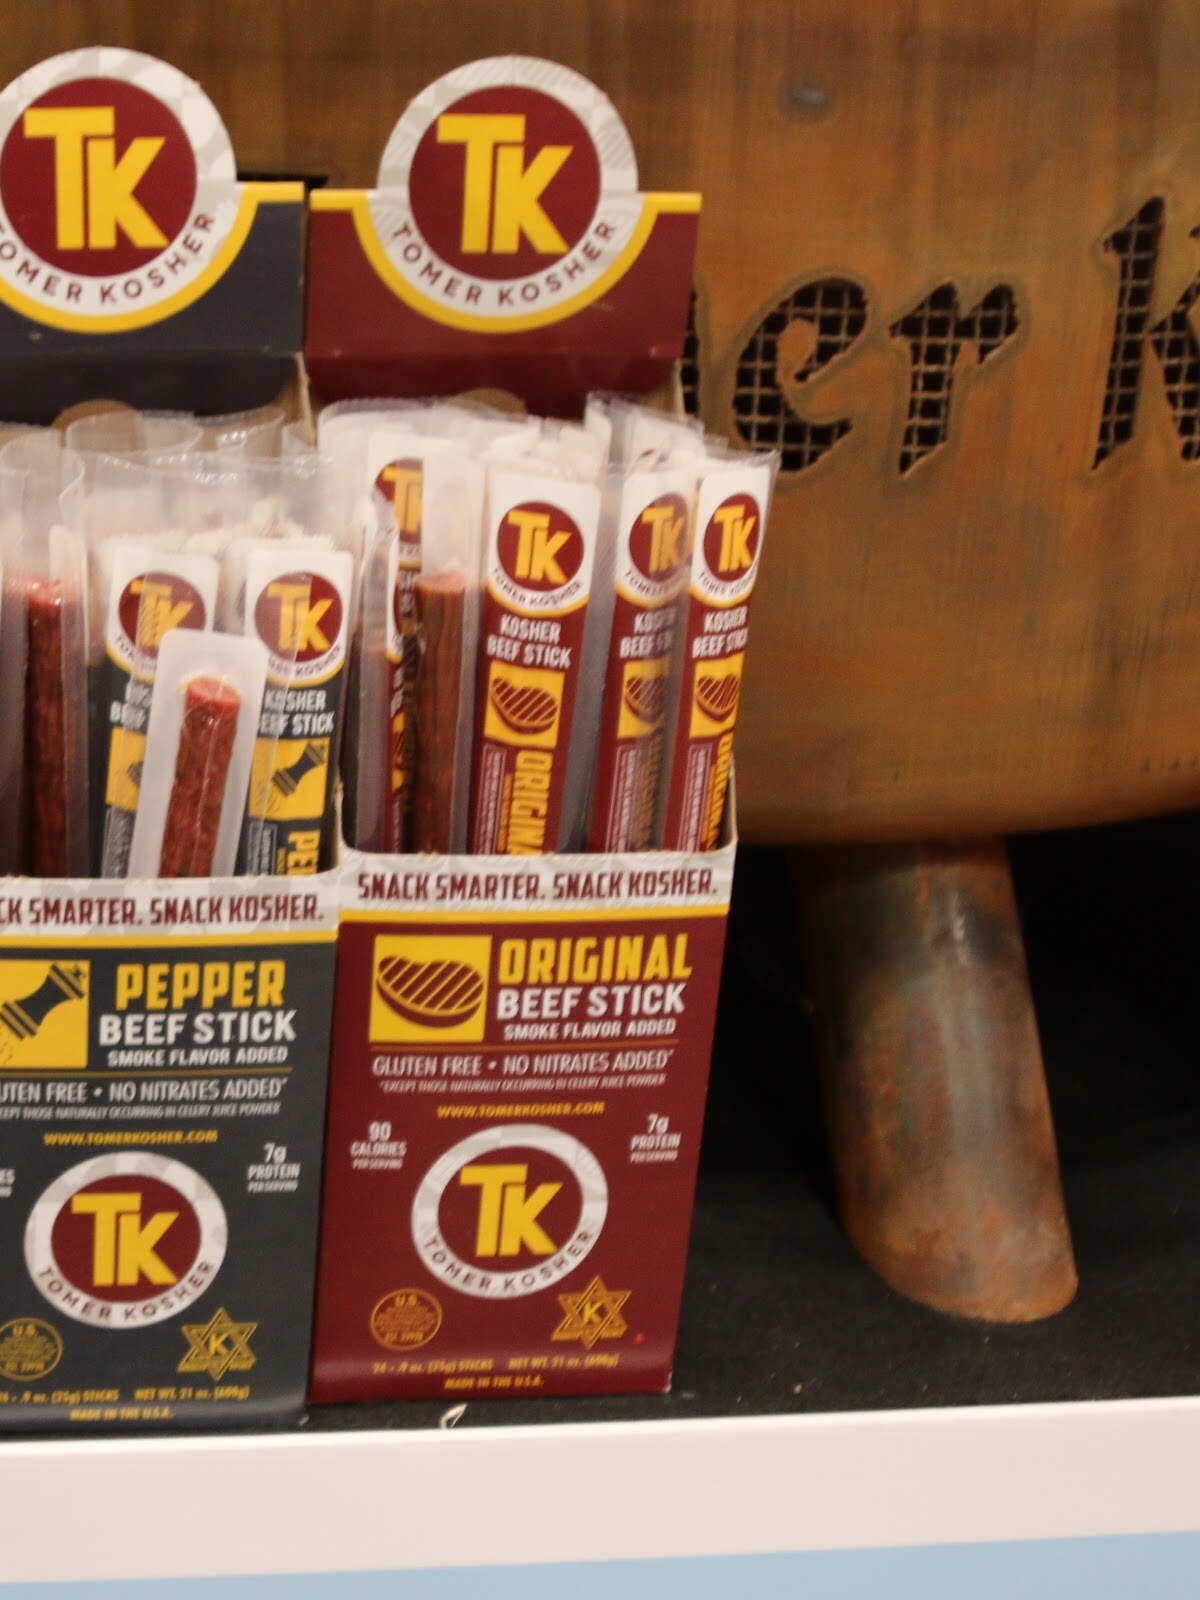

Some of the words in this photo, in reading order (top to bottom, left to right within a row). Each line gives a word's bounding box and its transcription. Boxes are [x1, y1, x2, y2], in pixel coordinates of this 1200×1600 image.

[100, 213, 214, 303] KOSHER
[394, 221, 480, 304] TOMER
[500, 223, 615, 306] KOSHER
[682, 277, 1020, 476] er
[501, 614, 561, 644] KOSHER
[486, 634, 522, 662] BEEF
[523, 643, 572, 669] STICK
[692, 634, 726, 660] BEEF
[265, 689, 327, 712] KOSHER
[291, 711, 335, 736] STICK
[358, 873, 429, 901] SNACK
[436, 873, 545, 900] SMARTER.
[553, 871, 622, 898] SNACK
[629, 868, 717, 897] KOSHER.
[29, 898, 143, 925] SMARTER.
[150, 897, 221, 925] SNACK
[229, 893, 324, 922] KOSHER.
[499, 933, 692, 985] ORIGINAL
[116, 960, 286, 1010] PEPPER
[497, 986, 580, 1020] BEEF
[588, 982, 686, 1016] STICK
[100, 1013, 185, 1046] BEEF
[193, 1010, 296, 1043] STICK
[504, 1024, 558, 1041] SMOKE
[563, 1022, 621, 1038] FLAVOR
[626, 1019, 675, 1036] ADDED
[108, 1050, 163, 1067] SMOKE
[169, 1049, 229, 1066] FLAVOR
[235, 1046, 287, 1064] ADDED
[372, 1055, 438, 1077] GLUTEN
[442, 1055, 482, 1076] FREE
[503, 1053, 528, 1074] NO
[533, 1052, 609, 1074] NITRATES
[46, 1082, 87, 1103] FREE
[108, 1080, 136, 1101] NO
[141, 1079, 219, 1101] NITRATES
[369, 1121, 391, 1141] 90
[647, 1115, 669, 1134] 7g
[264, 1143, 286, 1164] 7g
[631, 1134, 681, 1151] PROTEIN
[247, 1163, 300, 1180] PROTEIN
[426, 1238, 491, 1289] TOMER
[502, 1230, 591, 1290] KOSHER
[39, 1267, 111, 1320] TOMER
[123, 1261, 214, 1320] KOSHER
[583, 1302, 601, 1322] K
[210, 1334, 228, 1356] K
